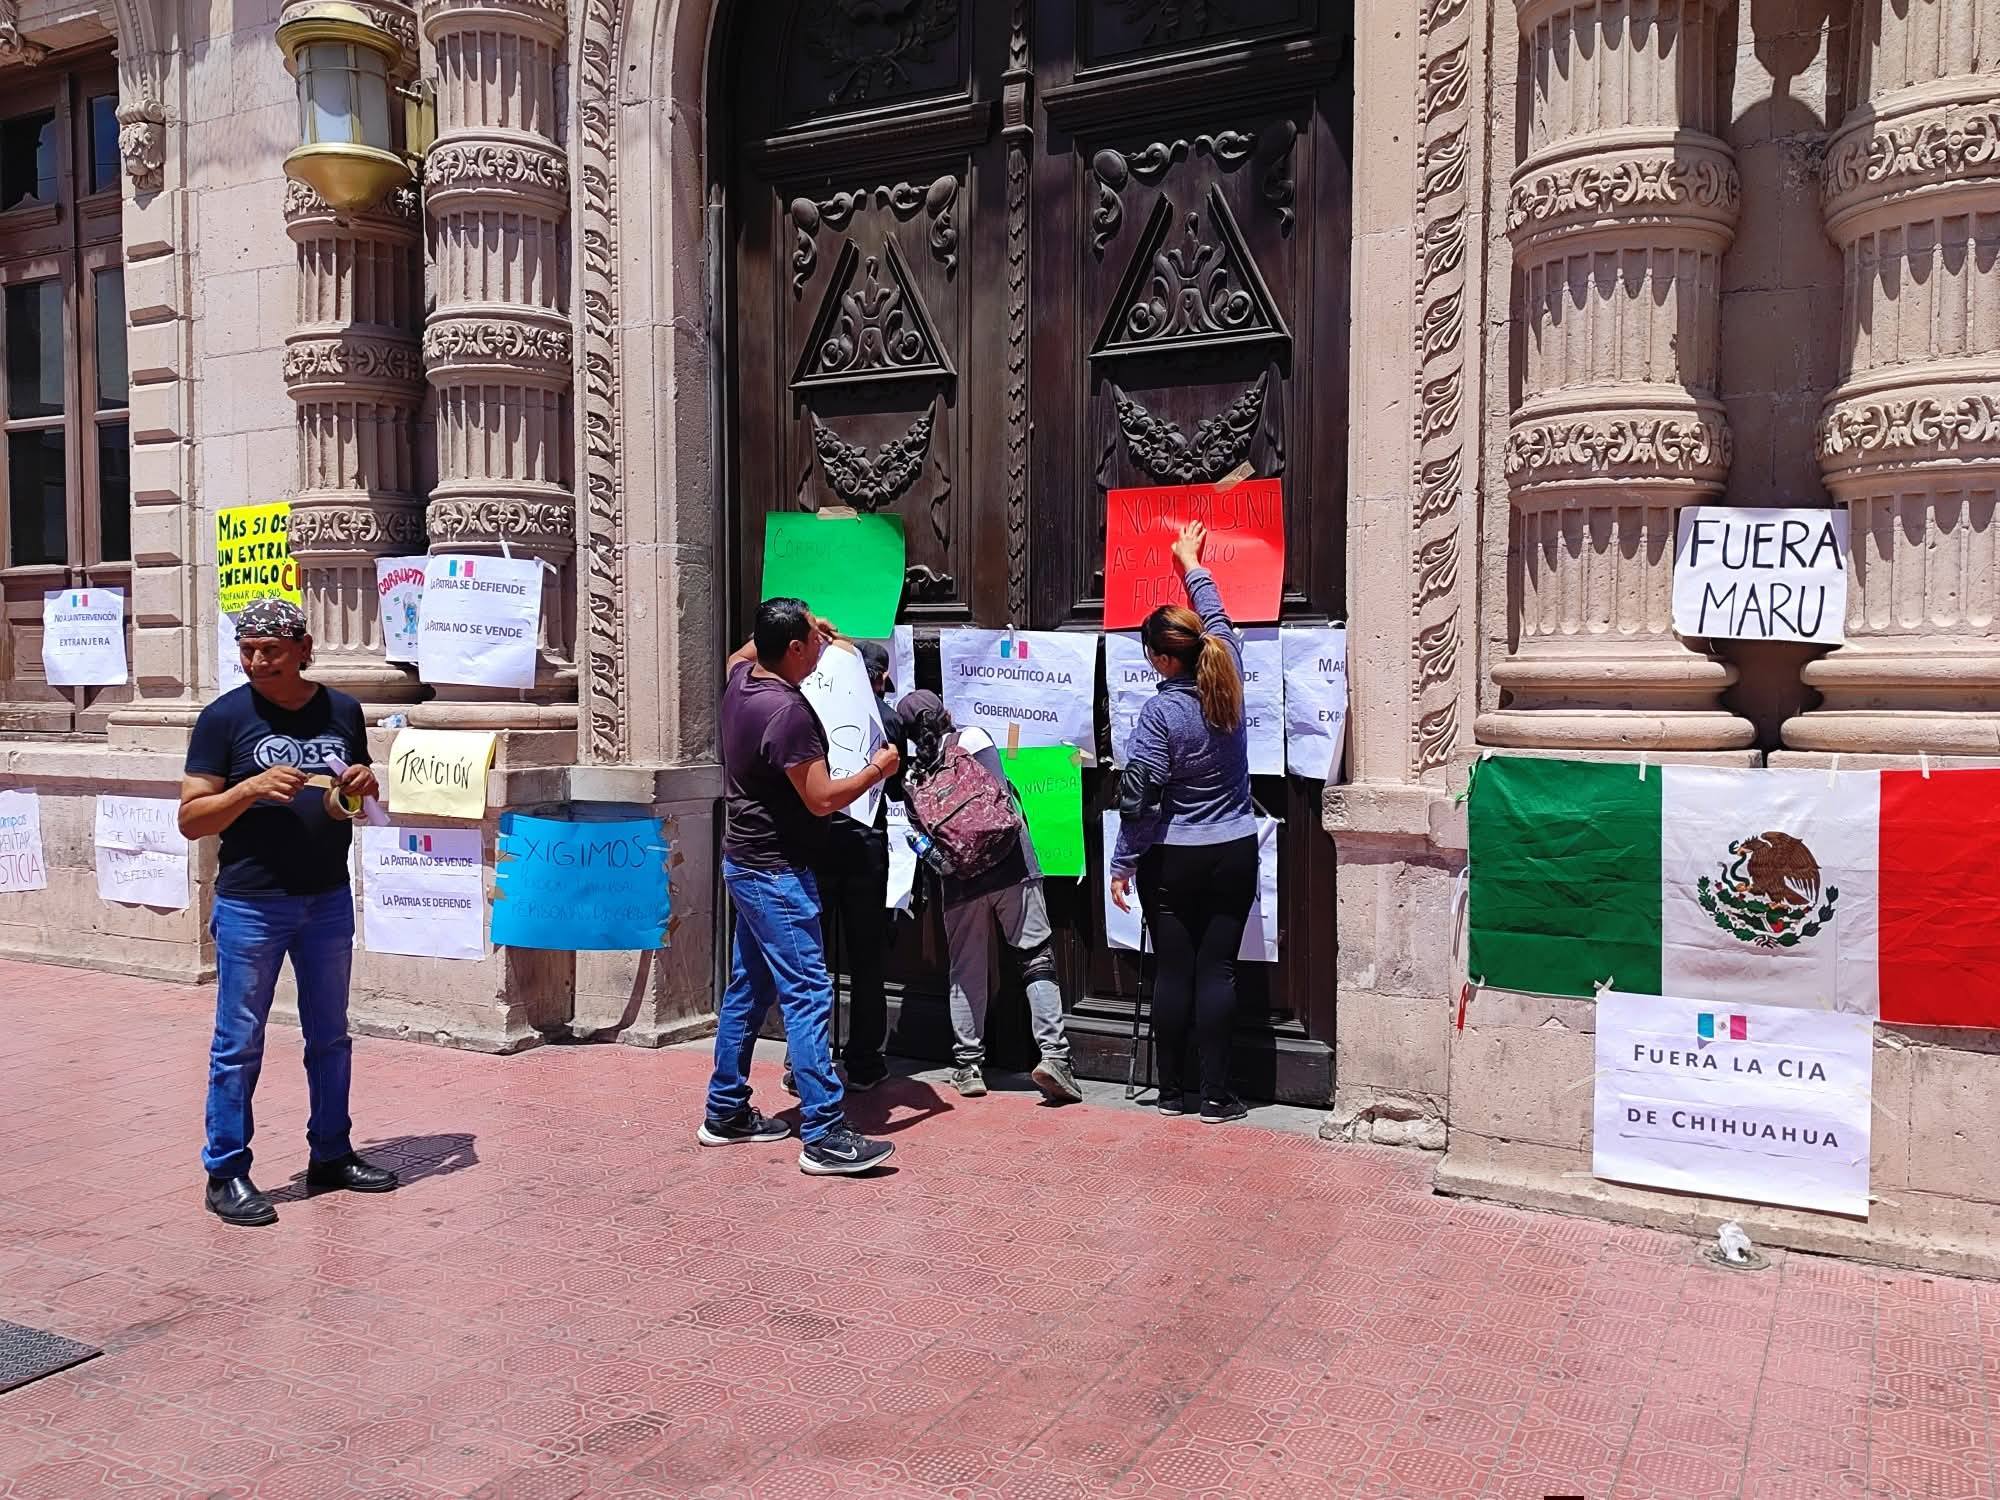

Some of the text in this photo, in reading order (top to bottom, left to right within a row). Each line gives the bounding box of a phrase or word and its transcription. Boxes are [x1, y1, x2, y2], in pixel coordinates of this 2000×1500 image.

[1121, 494, 1151, 537] NO
[252, 517, 266, 535] SI
[1689, 519, 1844, 571] FUERA
[218, 547, 234, 567] UN
[219, 564, 280, 589] ENEMIGO
[460, 580, 470, 591] SE
[472, 580, 527, 596] DEFIENDE
[1697, 582, 1825, 638] MARU
[452, 623, 468, 634] NO
[471, 624, 482, 635] SE
[485, 626, 523, 638] VENDE
[59, 637, 111, 647] EXTRANJERA
[959, 663, 1072, 684] JUICIO POLÍTICO A LA
[1125, 670, 1139, 683] LA
[973, 701, 1059, 723] GOBERNADORA
[380, 854, 473, 868] LA PATRIA NO SE VENDE
[382, 895, 472, 909] LA PATRIA SE DEFIENDE
[1633, 1043, 1827, 1082] FUERA LA CIA
[1627, 1108, 1839, 1148] DE CHIHUAHUA
